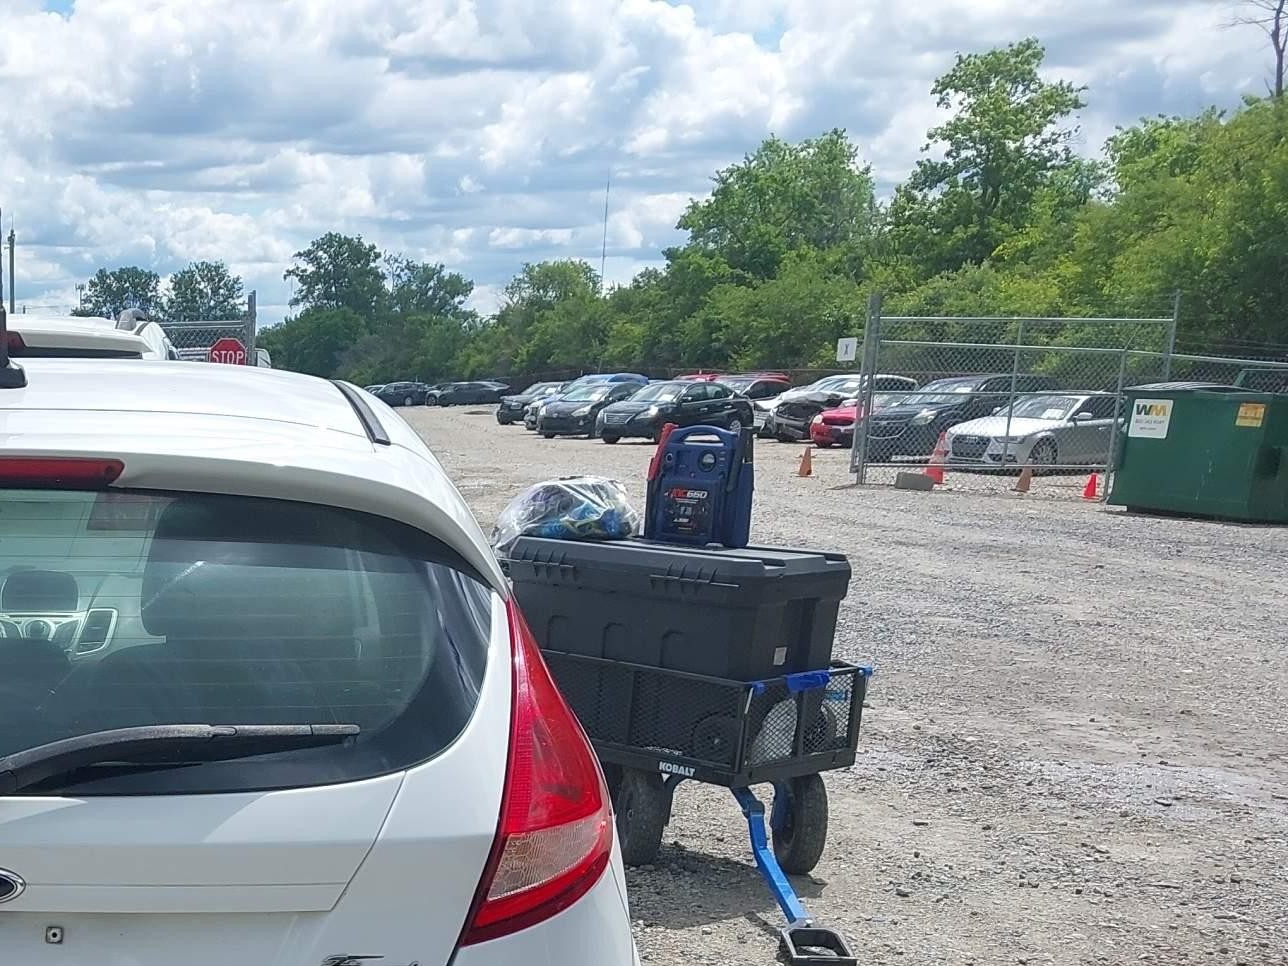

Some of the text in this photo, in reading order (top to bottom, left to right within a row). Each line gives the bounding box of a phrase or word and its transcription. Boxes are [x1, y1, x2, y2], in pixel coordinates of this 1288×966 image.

[212, 350, 244, 365] STOP
[1135, 404, 1168, 416] WM
[659, 761, 696, 777] KOBALT
